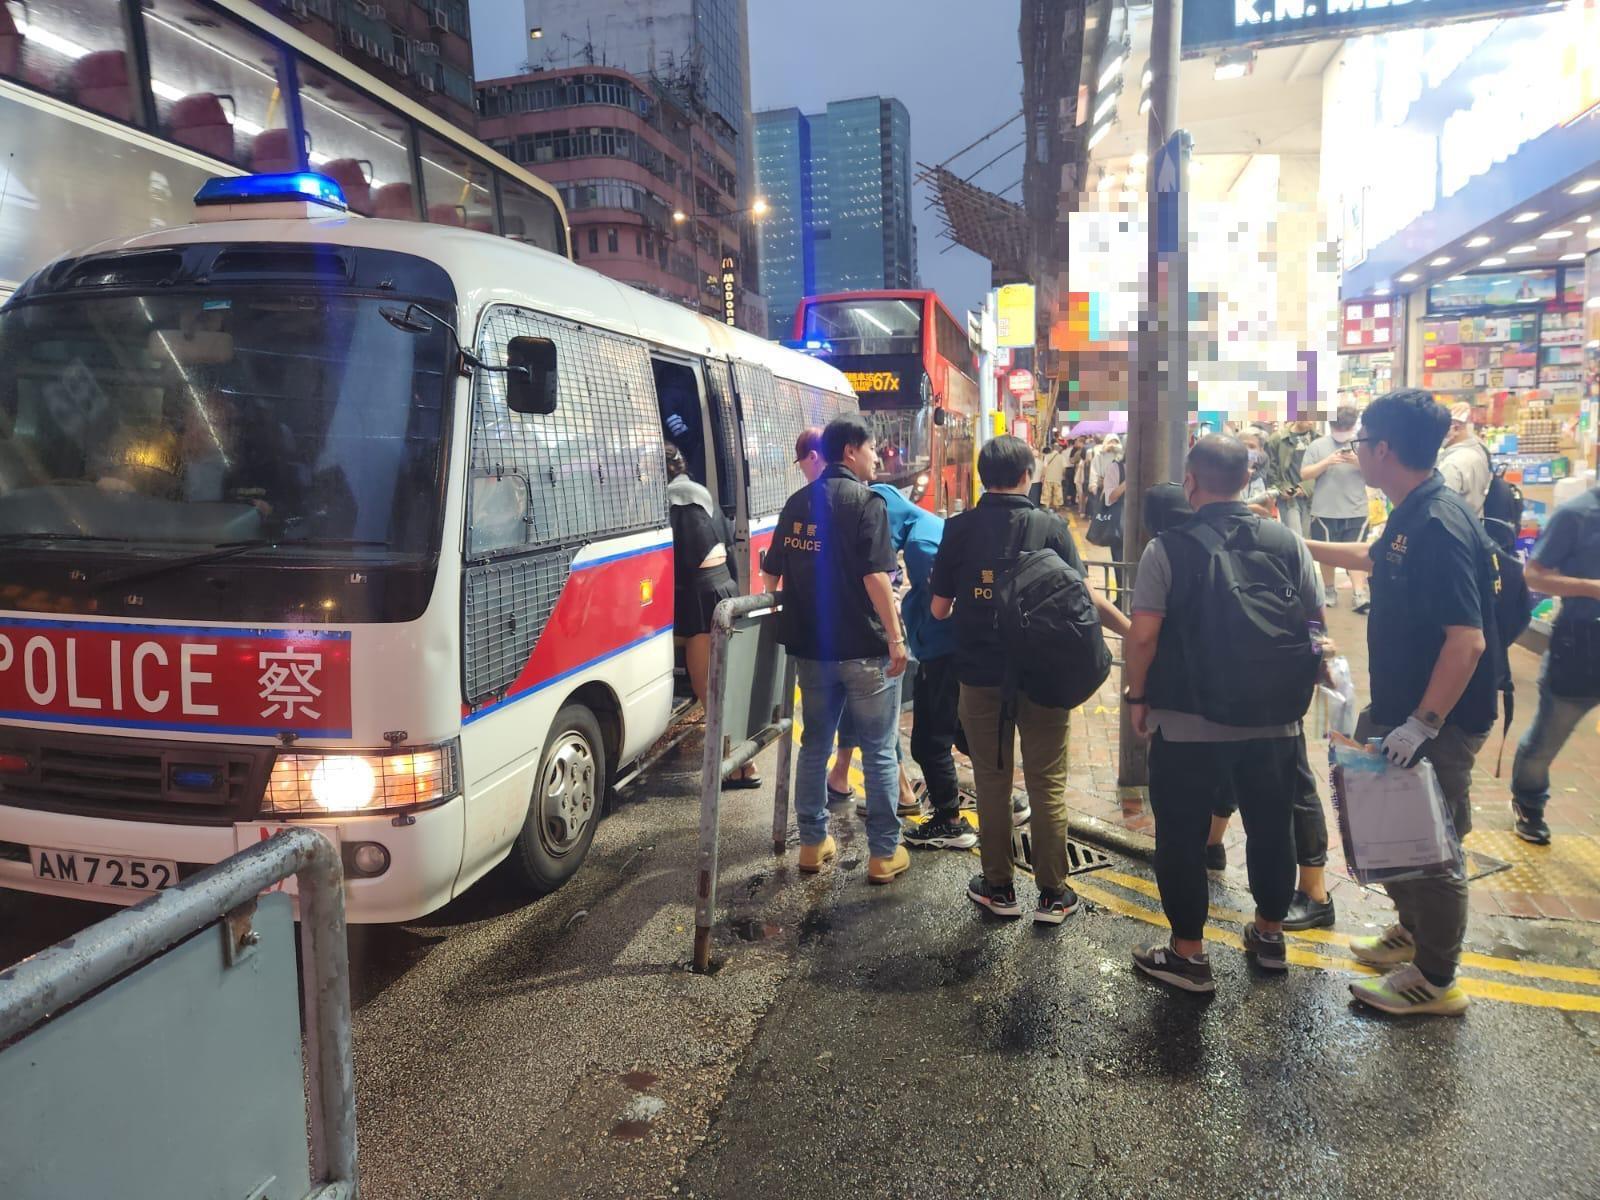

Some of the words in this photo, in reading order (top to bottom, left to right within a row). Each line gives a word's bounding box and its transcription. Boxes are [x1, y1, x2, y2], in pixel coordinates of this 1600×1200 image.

[783, 536, 822, 552] POLICE
[974, 587, 993, 600] PO
[257, 646, 323, 720] 察
